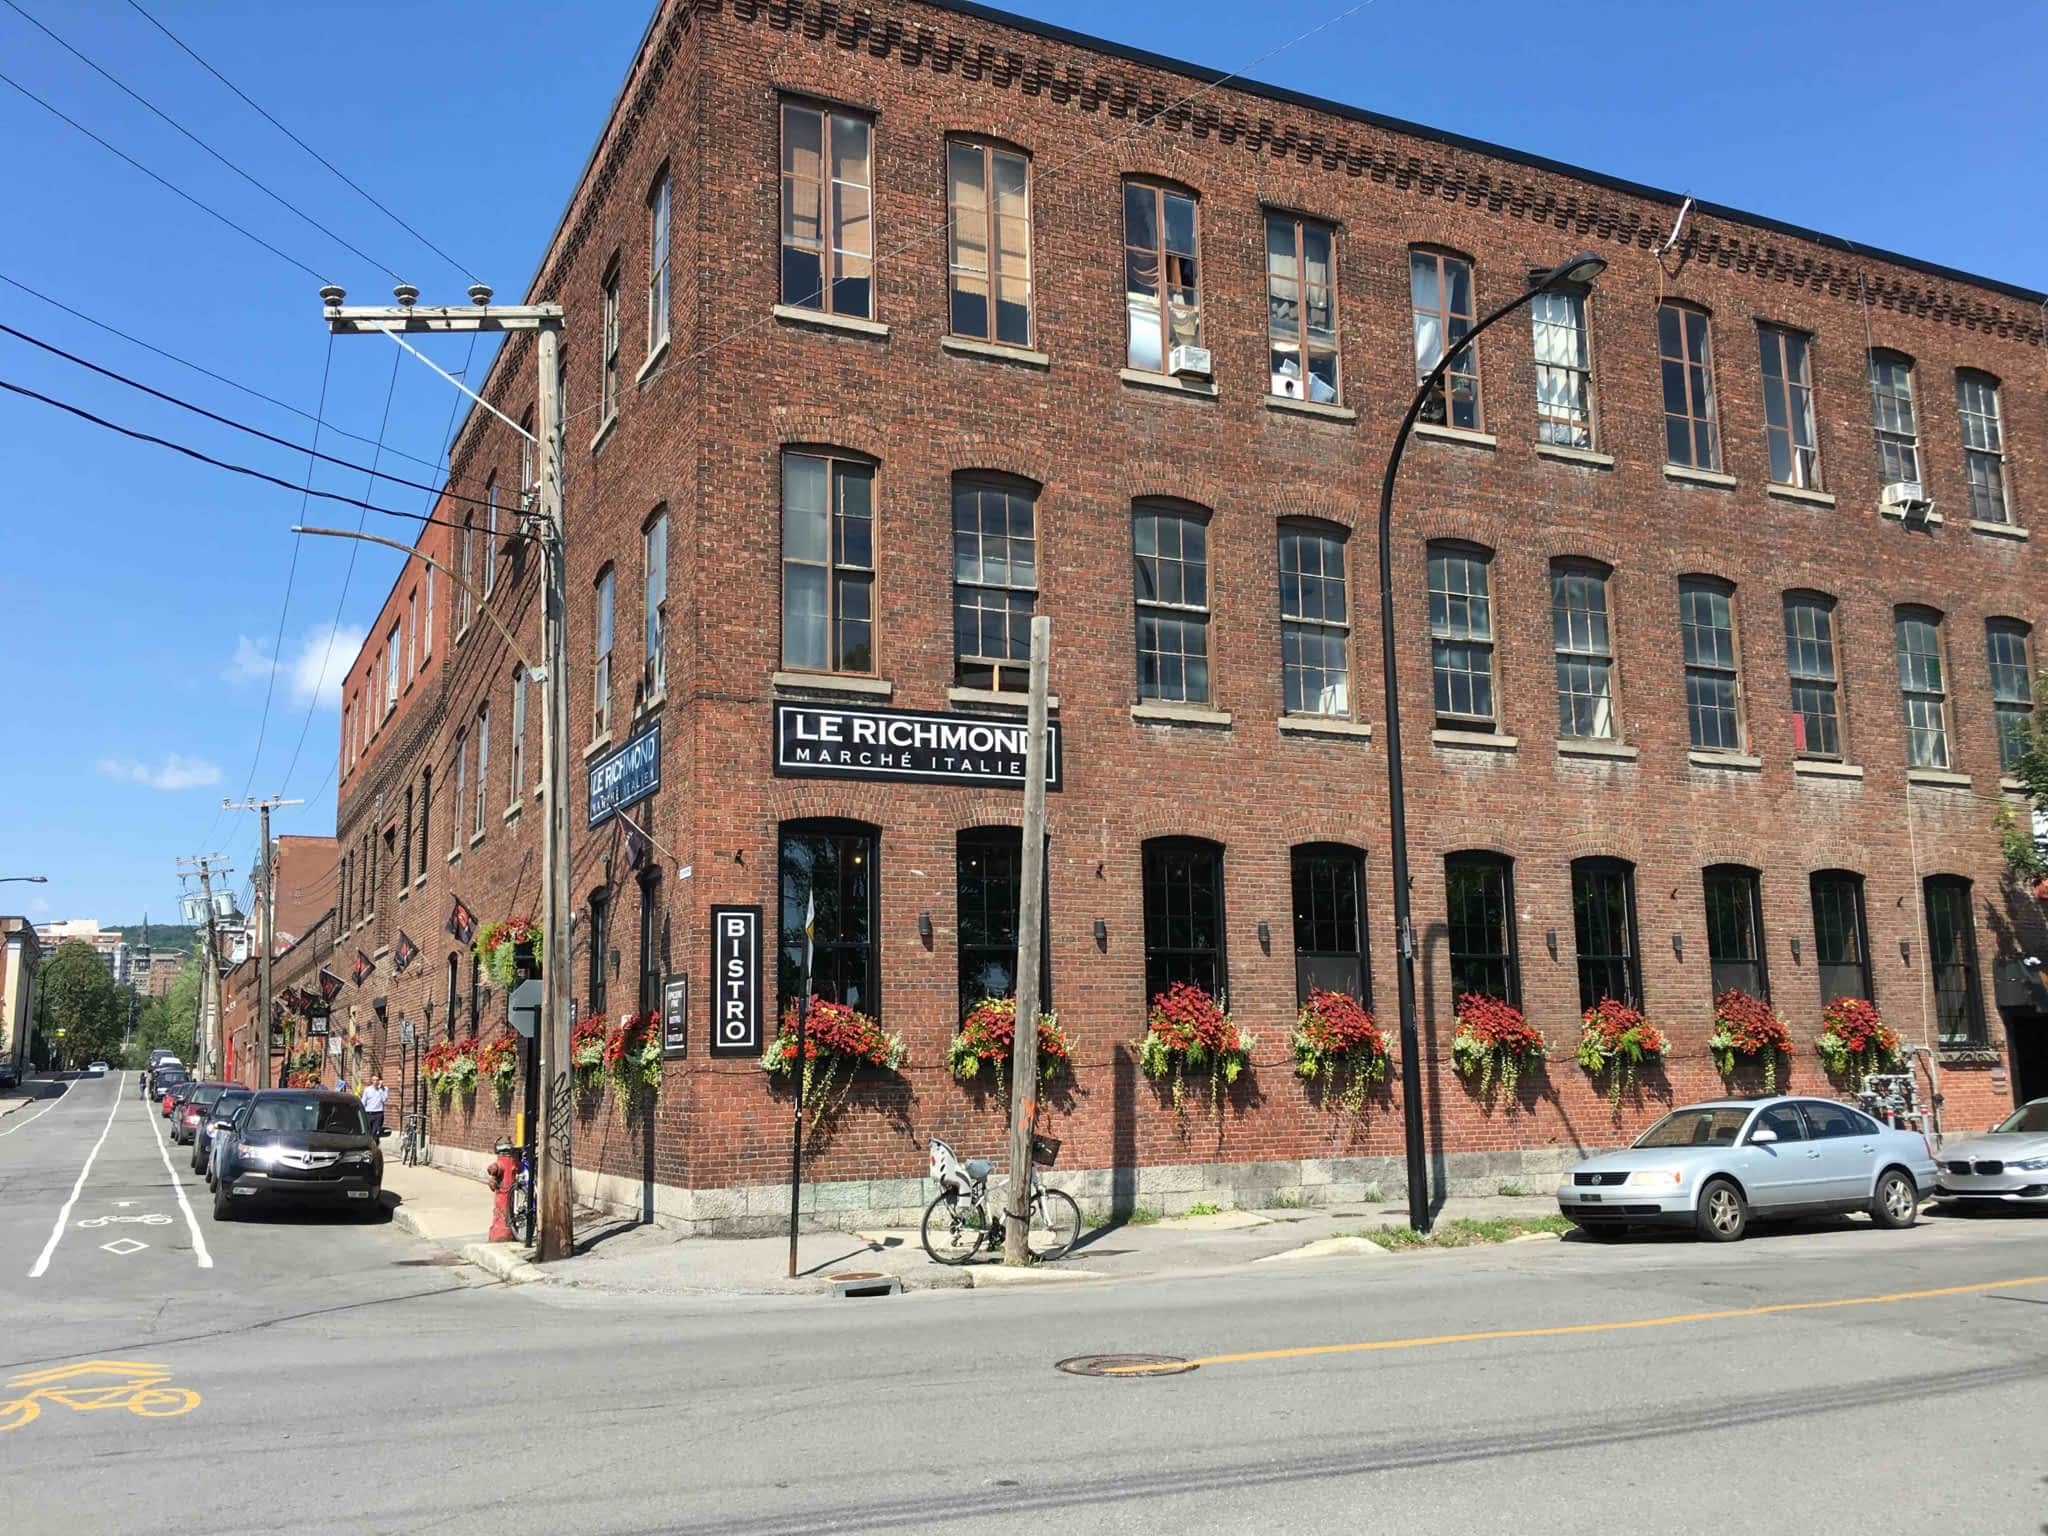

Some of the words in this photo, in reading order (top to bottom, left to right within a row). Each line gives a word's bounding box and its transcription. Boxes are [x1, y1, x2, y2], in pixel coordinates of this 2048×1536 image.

[796, 714, 843, 743] LE
[592, 770, 604, 796] LE
[605, 737, 656, 790] RICHMOND
[796, 748, 912, 768] MARCHÉ
[932, 756, 1022, 775] ITALIE
[725, 918, 746, 1040] BISTRO
